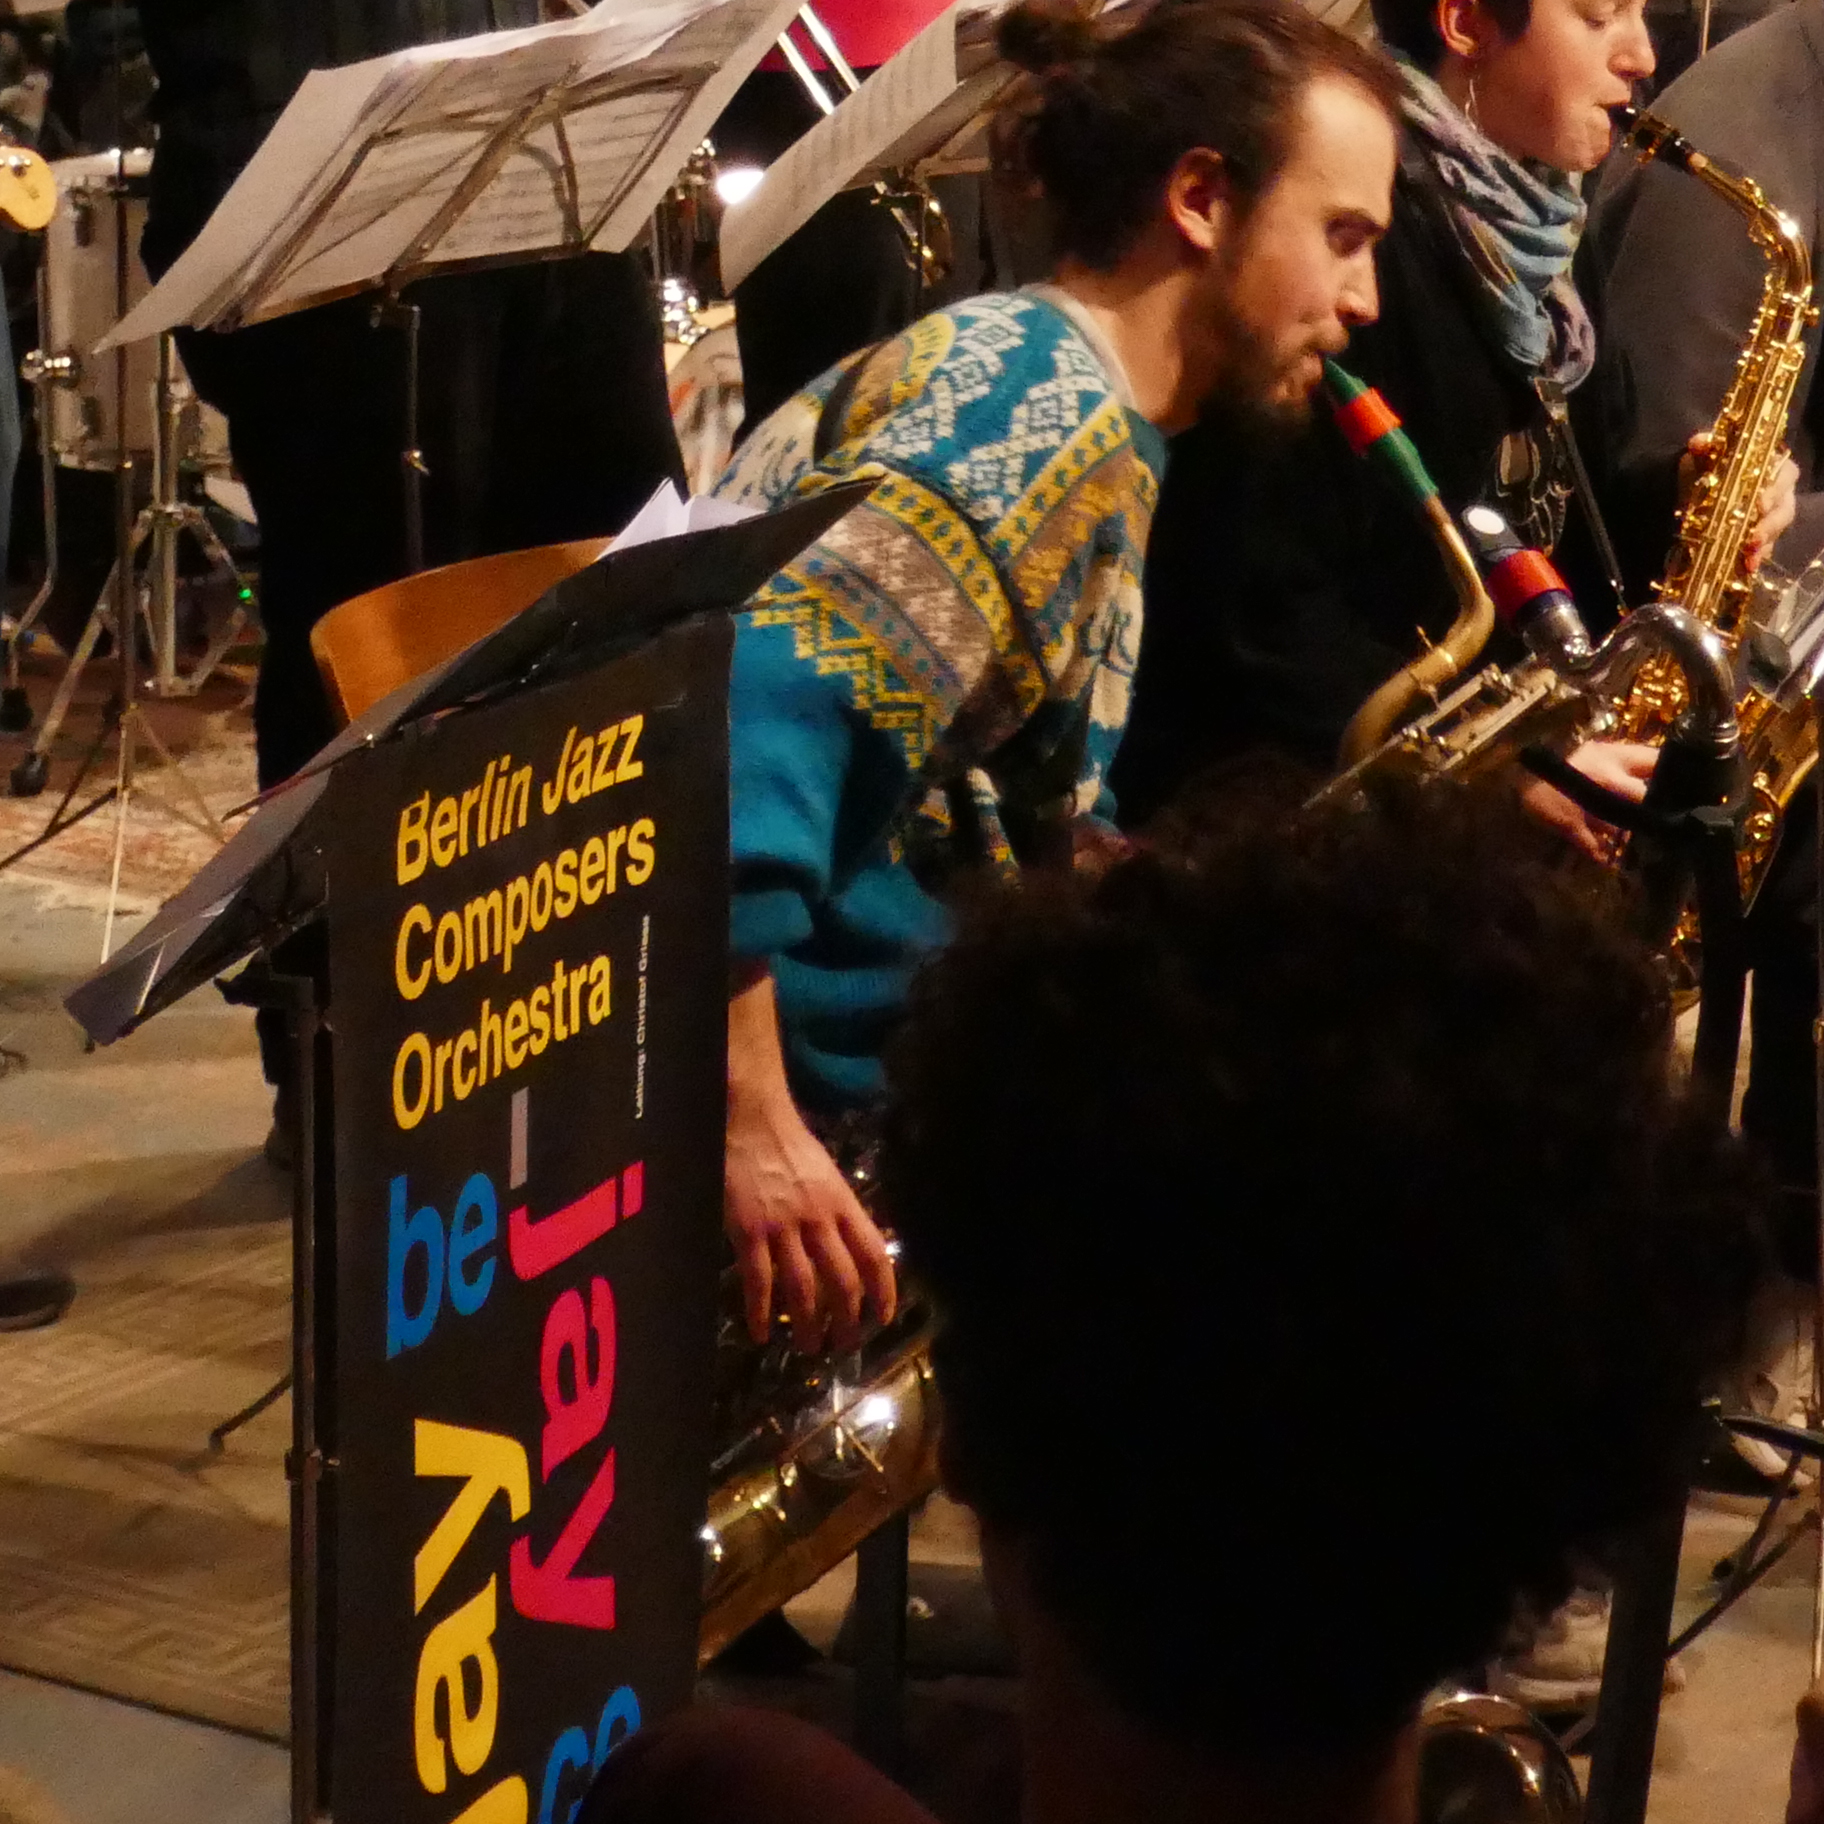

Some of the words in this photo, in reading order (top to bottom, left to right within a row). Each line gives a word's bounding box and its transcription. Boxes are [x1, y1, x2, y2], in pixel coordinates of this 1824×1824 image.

[397, 754, 533, 886] Berlin
[542, 714, 644, 816] Jazz
[395, 817, 656, 1001] Composers
[392, 953, 612, 1131] Orchestra
[385, 1172, 498, 1361] be
[507, 1159, 644, 1631] jay
